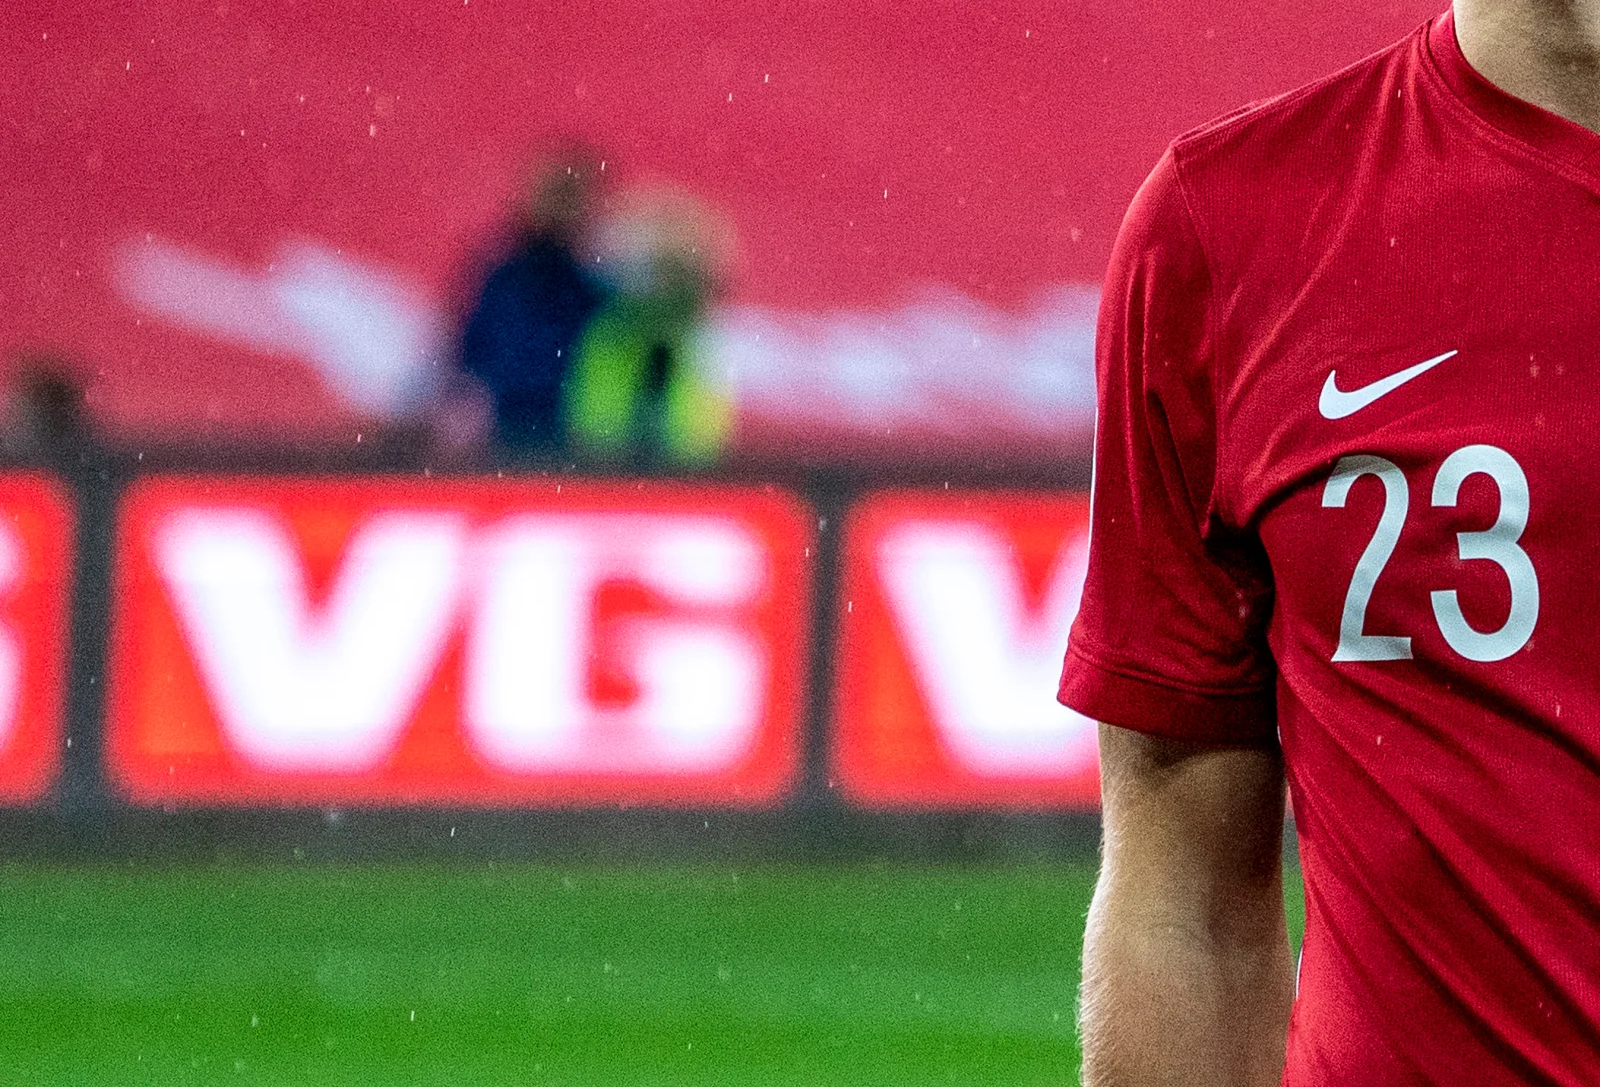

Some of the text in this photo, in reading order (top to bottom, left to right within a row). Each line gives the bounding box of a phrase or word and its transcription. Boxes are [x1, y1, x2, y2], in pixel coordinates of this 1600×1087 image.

[155, 509, 765, 774] VG
[880, 521, 1097, 774] V
[1321, 444, 1539, 662] 23
